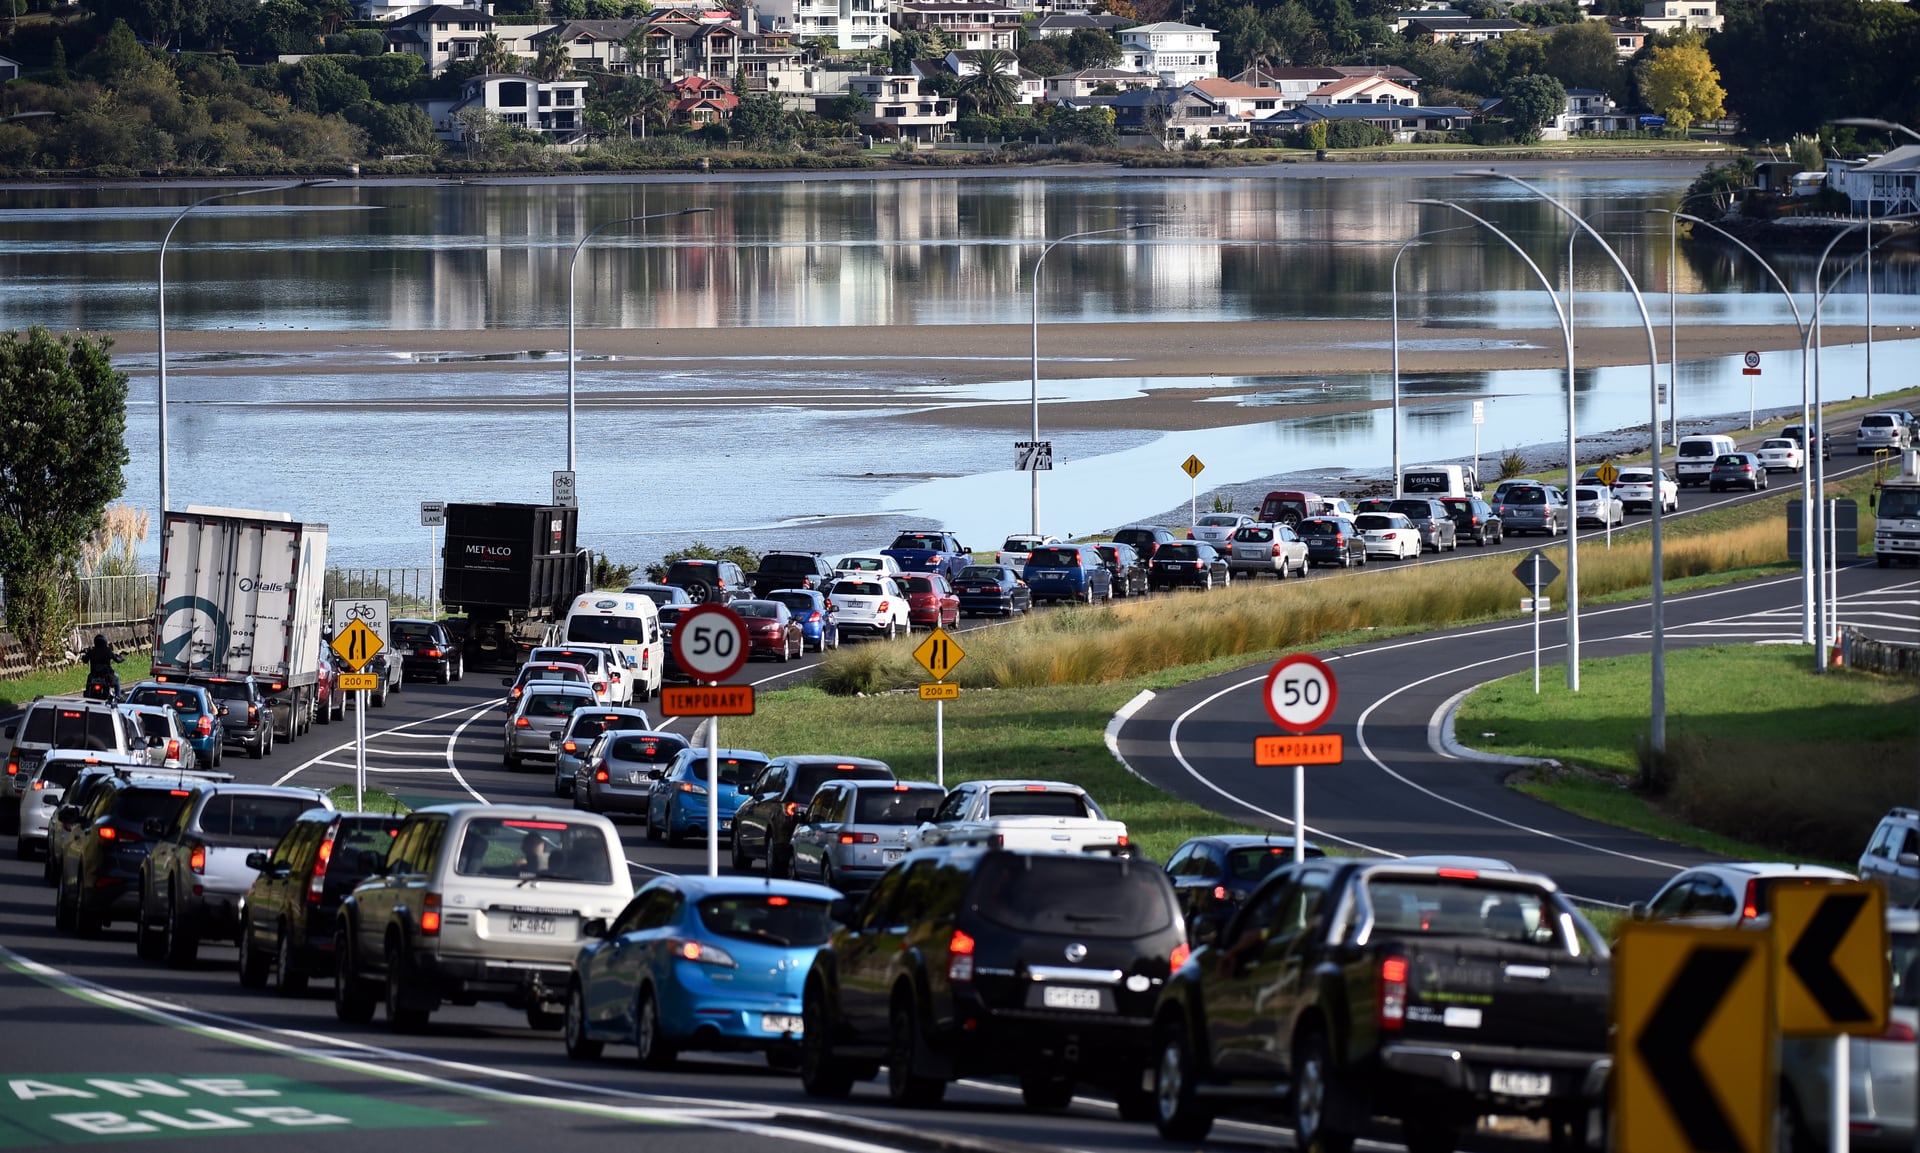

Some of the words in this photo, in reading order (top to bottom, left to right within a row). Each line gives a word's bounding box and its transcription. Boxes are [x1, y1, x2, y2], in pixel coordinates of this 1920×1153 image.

[1747, 354, 1758, 364] 50
[1035, 455, 1052, 470] ZIP
[465, 544, 512, 556] METALCO
[253, 581, 283, 592] Halls
[692, 626, 734, 657] 50
[344, 677, 361, 686] 200
[925, 687, 943, 696] 200
[1283, 678, 1322, 707] 50
[670, 693, 745, 709] TEMPORARY
[1264, 743, 1333, 758] TEMPORARY
[50, 1106, 353, 1135] BUS
